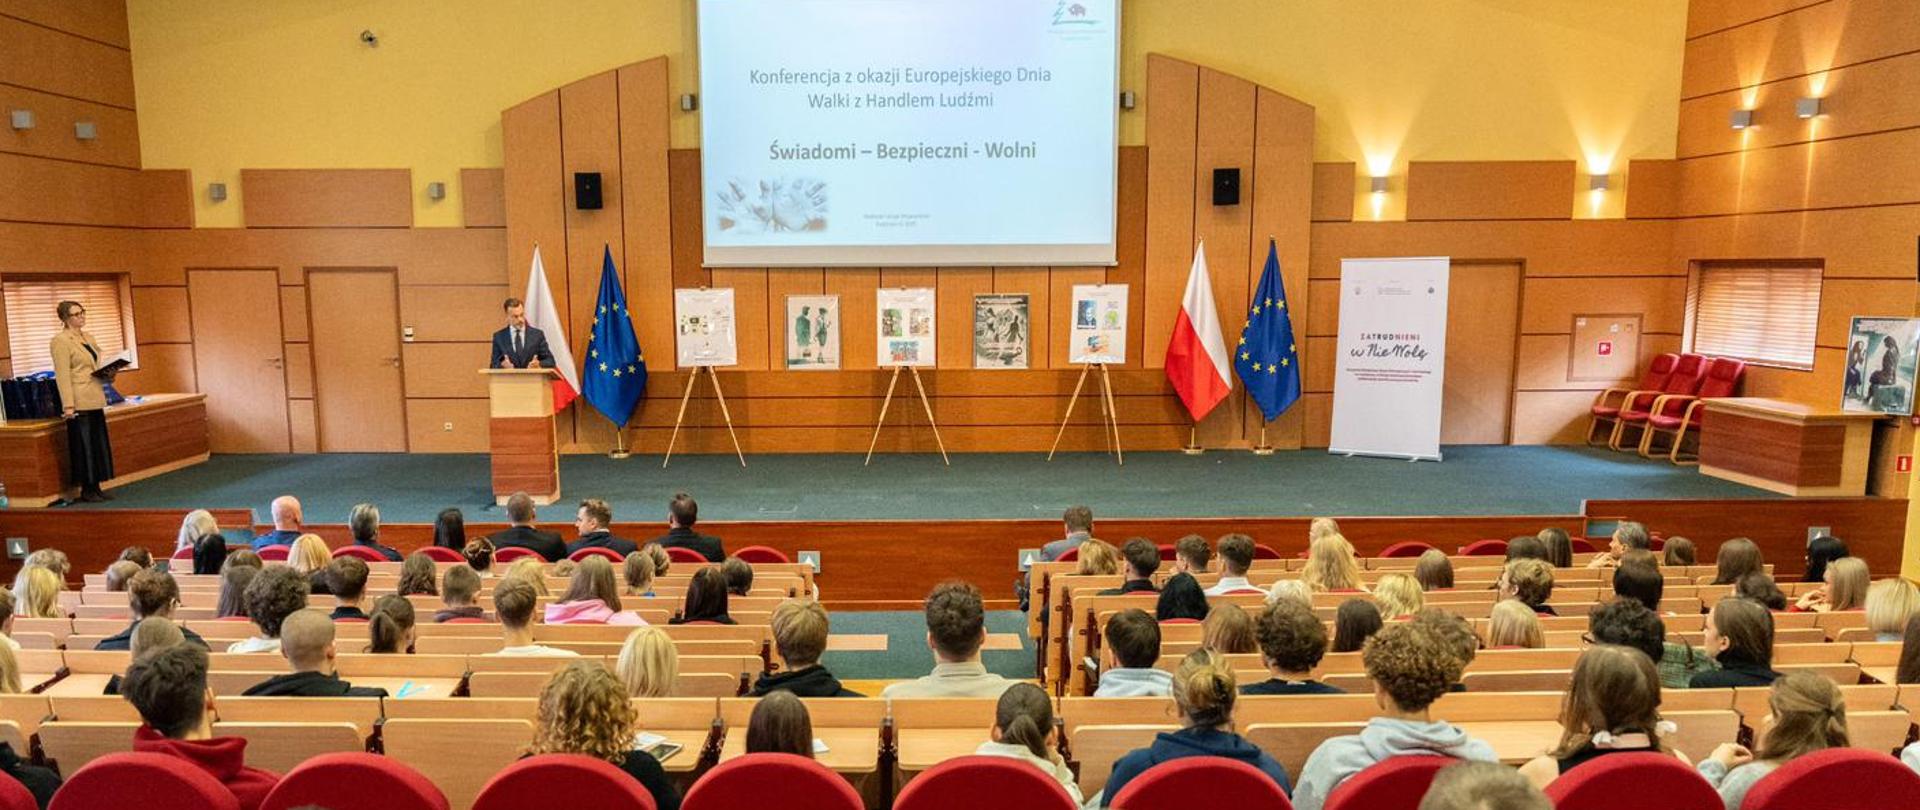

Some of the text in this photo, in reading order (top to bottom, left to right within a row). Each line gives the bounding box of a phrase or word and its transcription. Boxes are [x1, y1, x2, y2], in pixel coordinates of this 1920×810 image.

[750, 67, 1052, 87] Konferencja z okazji Europejskiego Dnia
[808, 91, 994, 109] Walki z Handlem Ludźmi
[770, 139, 856, 160] Świadomi
[877, 142, 968, 163] Bezpieczni
[984, 141, 1036, 158] Wolni
[1360, 333, 1421, 341] ZATRUDNIENI
